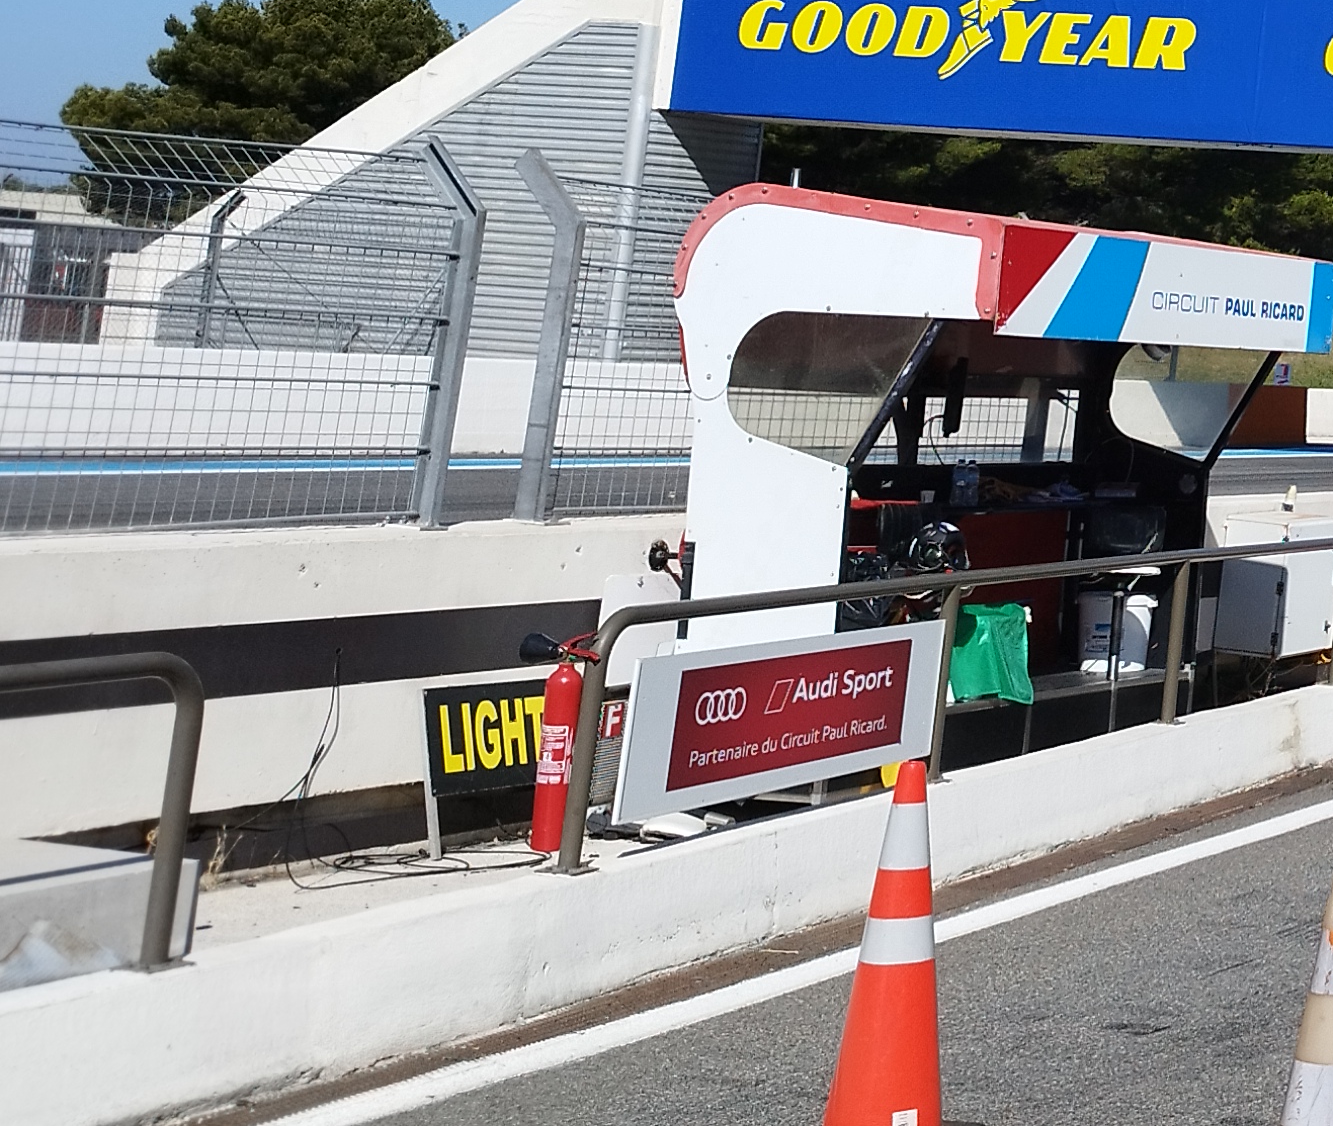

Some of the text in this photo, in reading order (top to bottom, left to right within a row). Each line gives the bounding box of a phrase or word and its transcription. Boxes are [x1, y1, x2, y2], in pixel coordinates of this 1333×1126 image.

[1152, 291, 1305, 321] CIRCUIT PAUL RICARD
[792, 666, 894, 704] Audi Sport
[688, 715, 888, 768] Partenaire du Circuit Paul Ricard.
